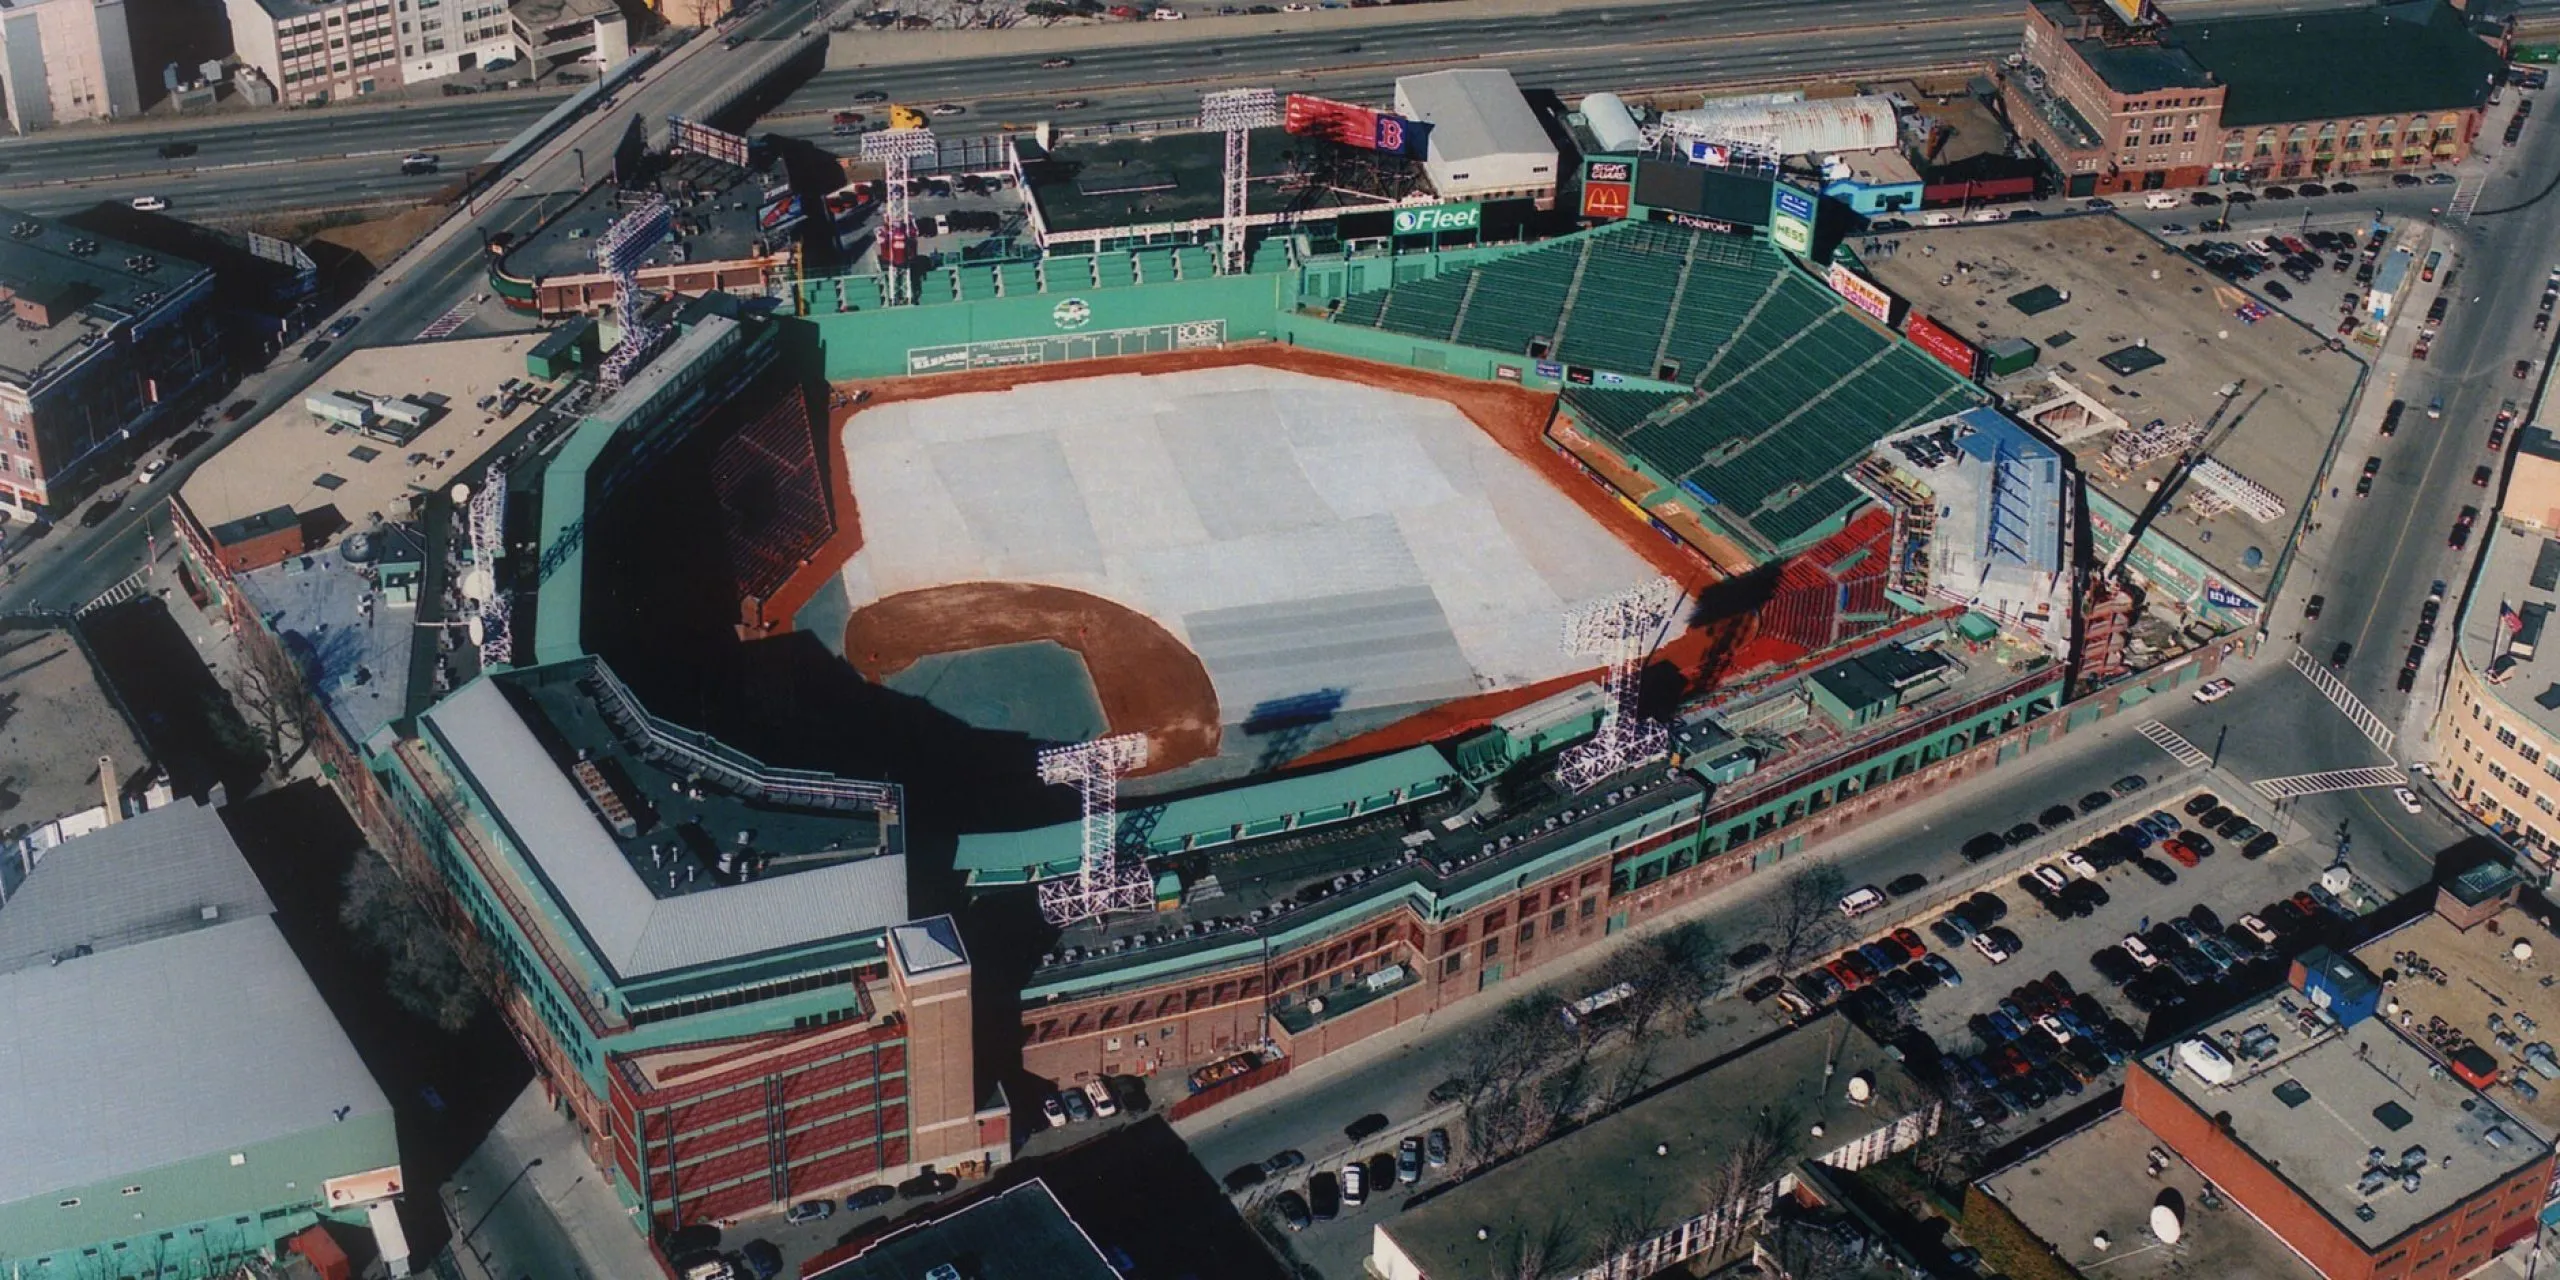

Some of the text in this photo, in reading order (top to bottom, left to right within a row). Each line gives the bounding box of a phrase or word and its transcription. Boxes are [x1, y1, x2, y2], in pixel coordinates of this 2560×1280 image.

[1378, 119, 1404, 150] B
[1591, 170, 1627, 180] GUARD
[1592, 163, 1628, 173] RIGHT
[1415, 207, 1480, 230] Fleet
[1678, 214, 1732, 233] Polaroid
[1777, 223, 1806, 245] HESS
[1843, 286, 1884, 319] DONUTS
